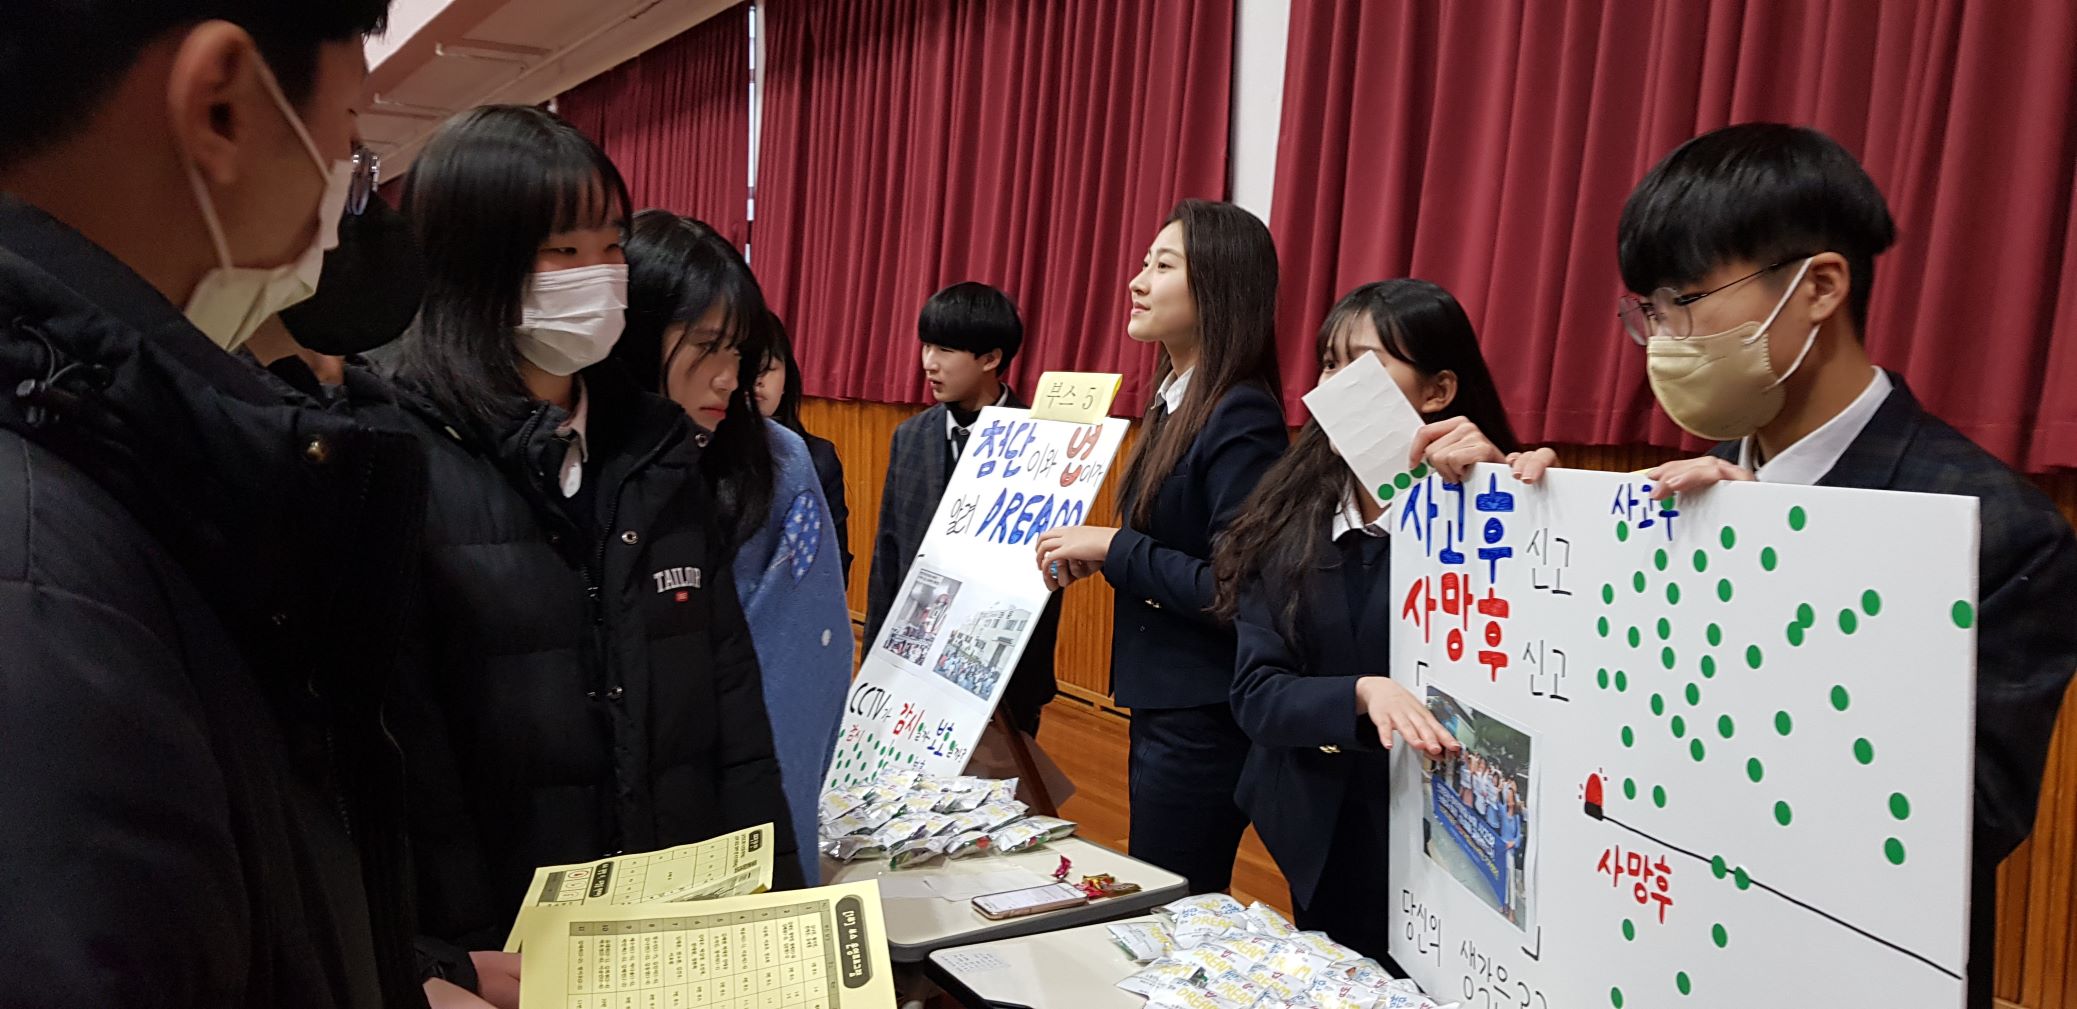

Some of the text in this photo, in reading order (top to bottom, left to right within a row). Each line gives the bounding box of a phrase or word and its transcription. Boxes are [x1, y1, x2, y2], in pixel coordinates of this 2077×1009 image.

[1046, 381, 1097, 410] 부스 5
[974, 487, 1083, 546] DREAM
[1400, 472, 1572, 596] 사고후 신고
[1402, 571, 1570, 702] 사망후 신고
[1597, 844, 1674, 924] 사망후
[1402, 889, 1441, 967] 당신의
